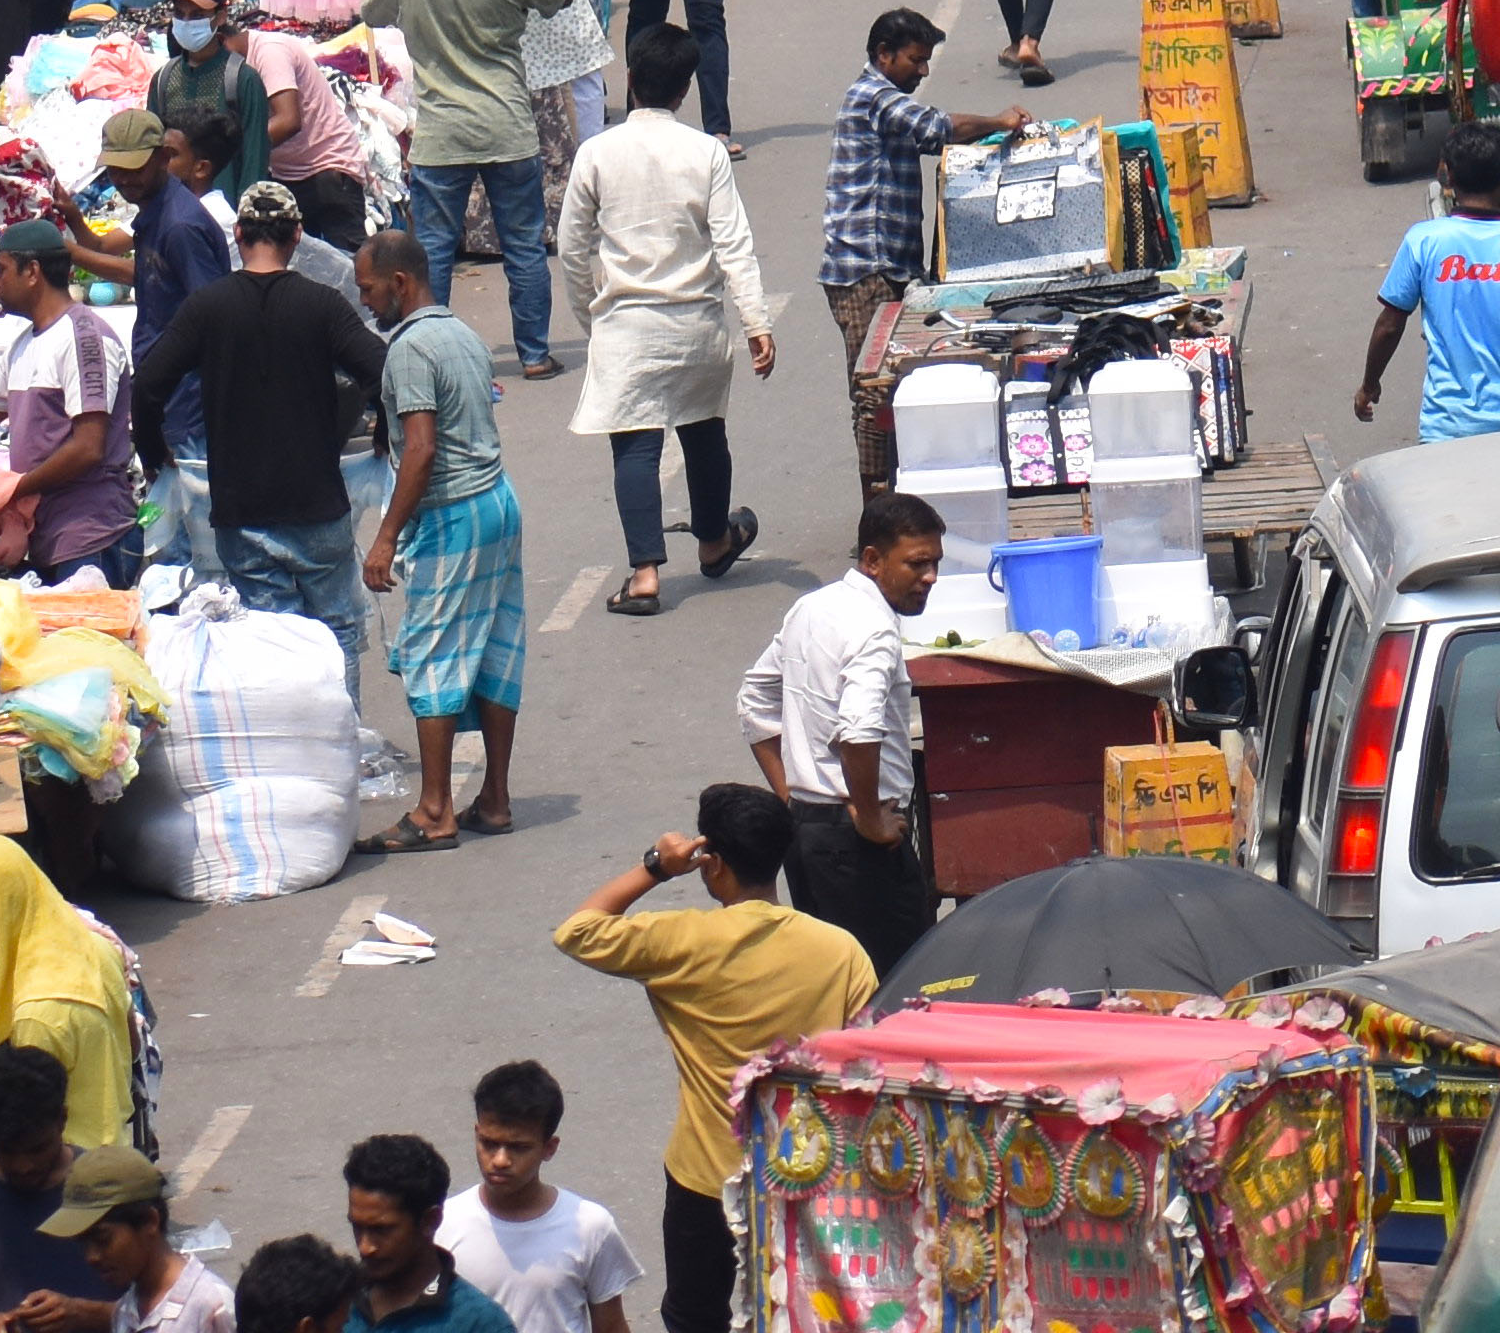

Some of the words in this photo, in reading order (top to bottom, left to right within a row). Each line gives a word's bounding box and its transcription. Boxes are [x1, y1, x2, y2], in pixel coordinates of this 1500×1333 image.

[1142, 35, 1224, 72] ট্রাফিক
[81, 334, 102, 367] YORK
[84, 370, 105, 400] CITY
